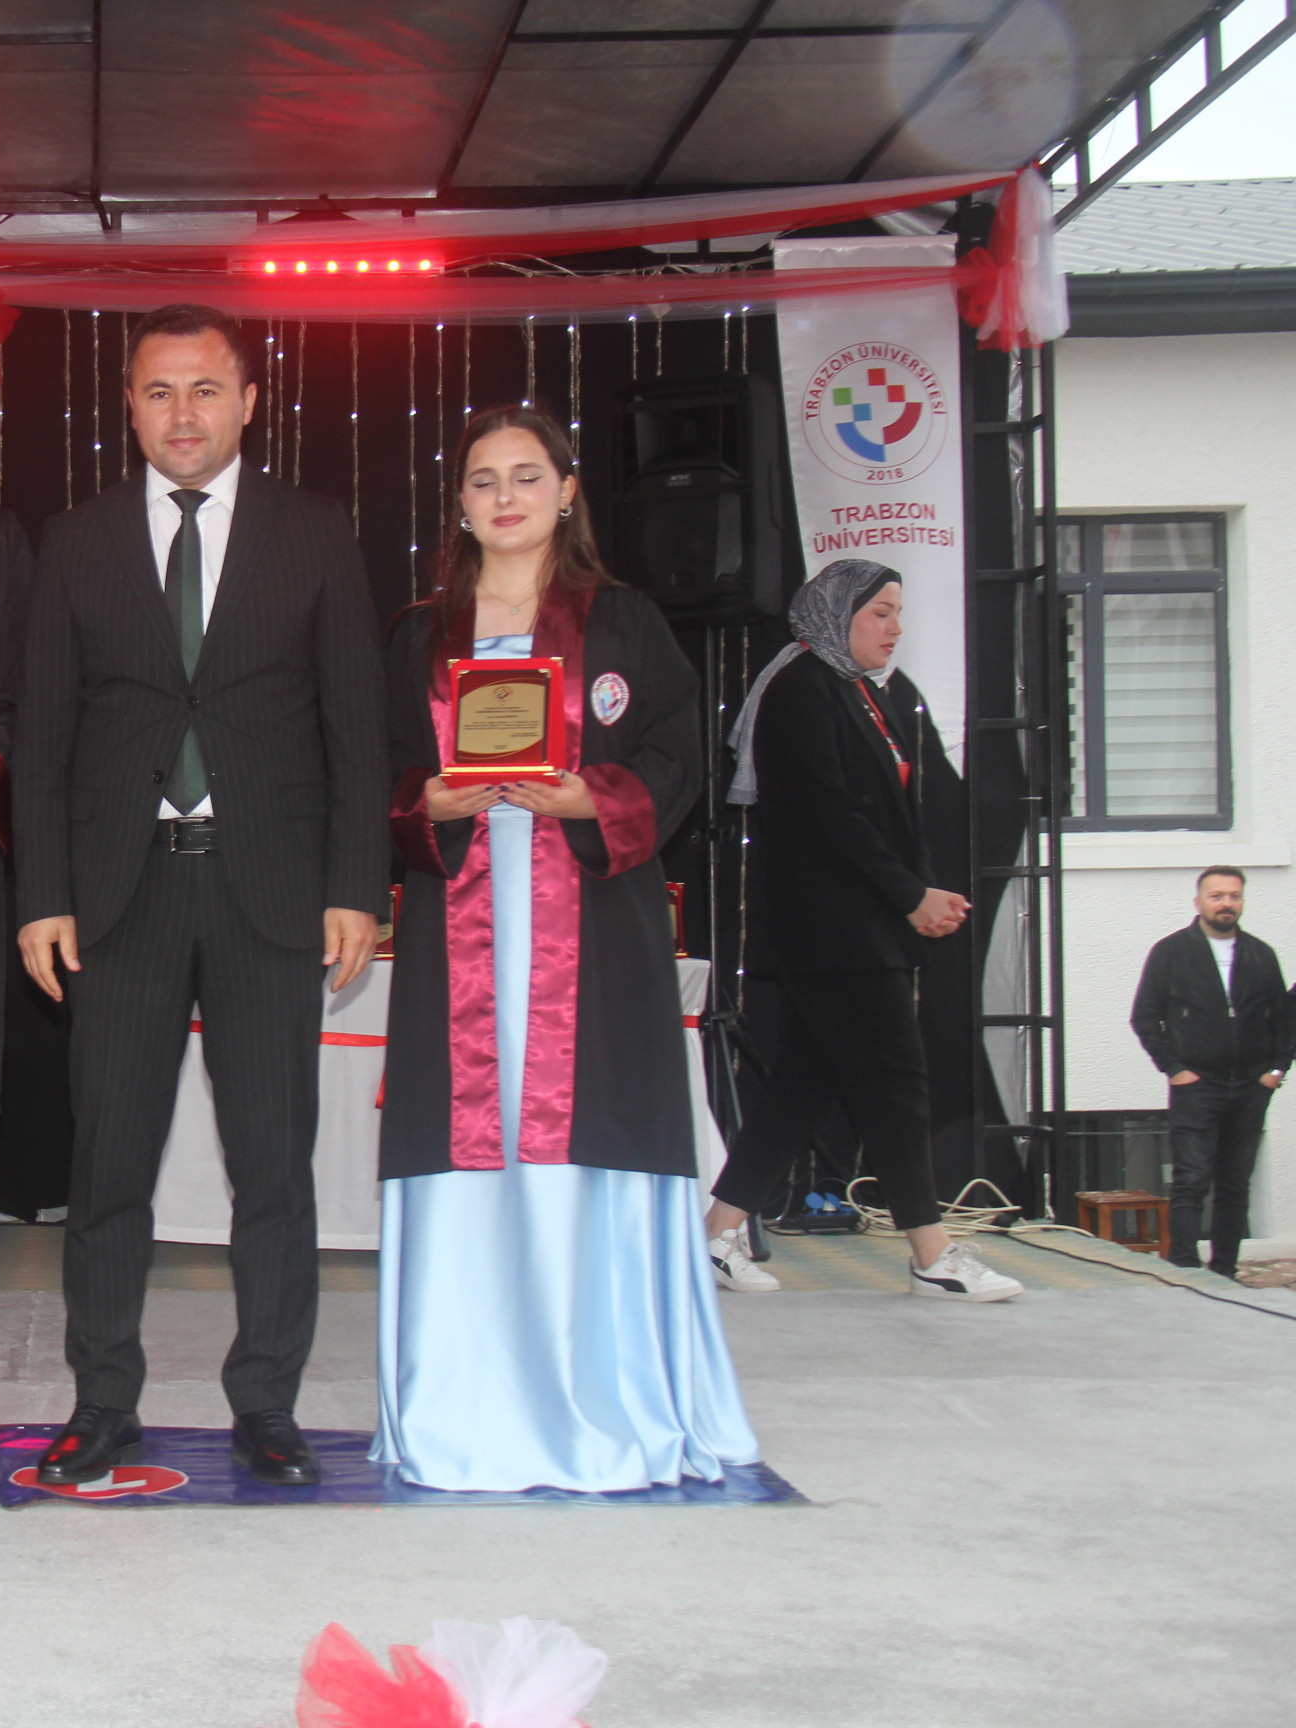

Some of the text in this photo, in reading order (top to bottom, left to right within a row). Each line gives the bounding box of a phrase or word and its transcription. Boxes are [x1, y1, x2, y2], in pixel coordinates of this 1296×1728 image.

[806, 344, 947, 421] TRABZON ÜNİVERSİTESİ
[866, 467, 904, 481] 2018
[831, 502, 936, 526] TRABZON
[813, 523, 955, 554] ÜNİVERSİTESİ
